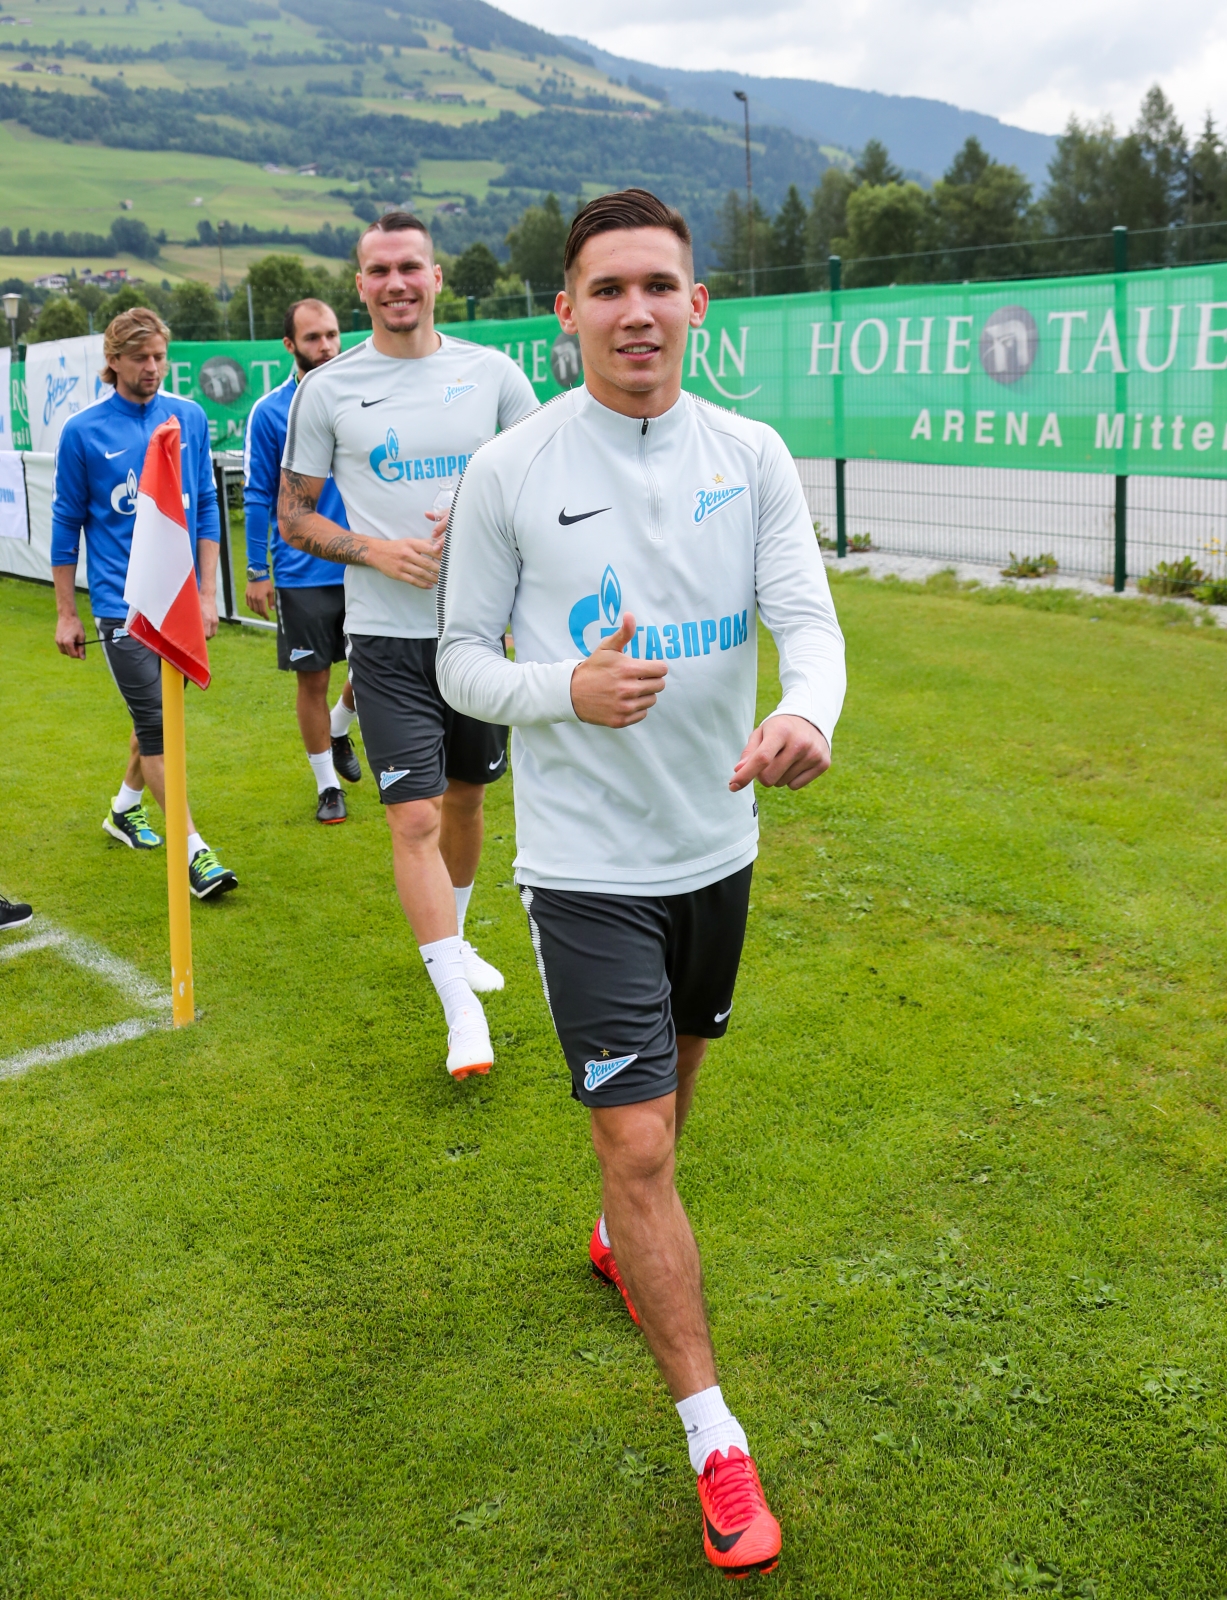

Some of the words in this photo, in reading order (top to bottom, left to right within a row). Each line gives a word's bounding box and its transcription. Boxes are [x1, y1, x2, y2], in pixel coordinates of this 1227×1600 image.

[806, 315, 974, 376] HOHE
[1047, 301, 1227, 375] TAUE
[910, 408, 1063, 447] ARENA
[629, 609, 748, 661] ГАЗПРОМ
